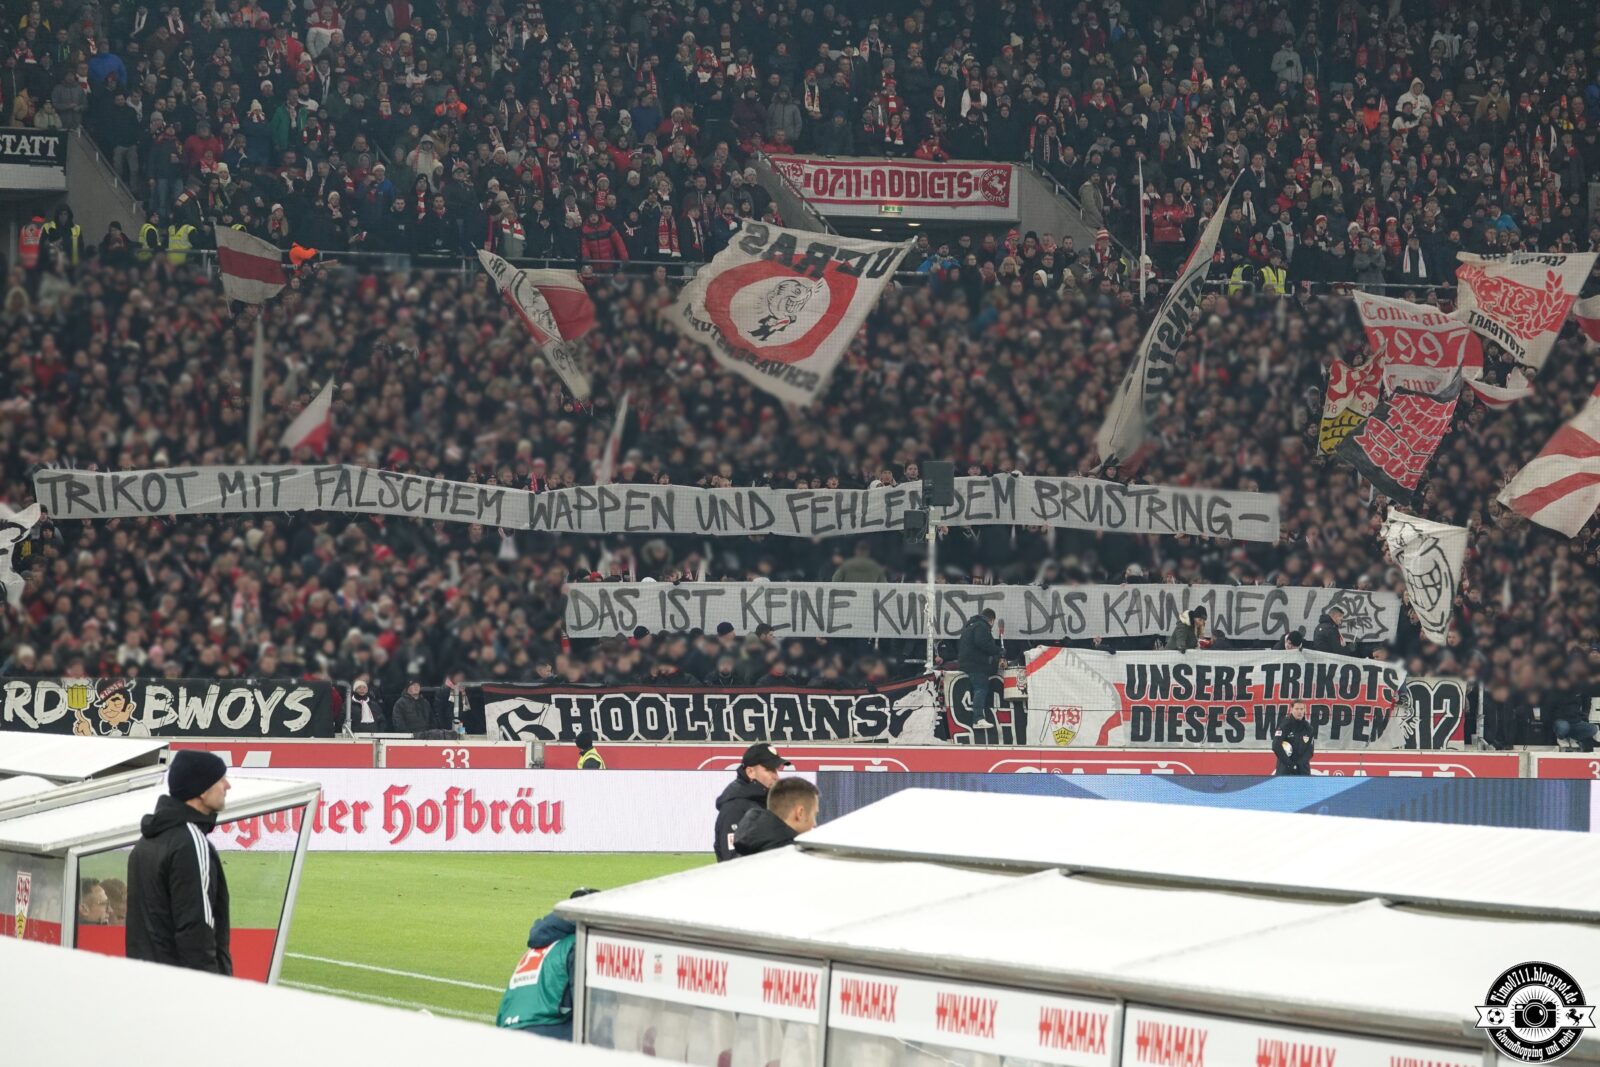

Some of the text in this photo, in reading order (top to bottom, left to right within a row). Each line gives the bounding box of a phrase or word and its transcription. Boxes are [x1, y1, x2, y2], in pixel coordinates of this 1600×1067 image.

[0, 134, 59, 157] TATT
[1372, 328, 1471, 367] 1997
[37, 471, 198, 516] TRIKOT
[217, 468, 298, 508] MIT
[313, 464, 505, 525] FALSCHEM
[528, 486, 675, 532] WAPPEN
[696, 490, 776, 531] UND
[1031, 479, 1233, 539] BRUSTRING
[569, 588, 640, 632] DAS
[659, 588, 726, 630] IST
[741, 586, 857, 633] KEINE
[873, 588, 1006, 637] KUNST
[1019, 590, 1087, 635] DAS
[1103, 588, 1190, 636] KANN
[1125, 662, 1400, 701] UNSERE TRIKOTS
[143, 684, 315, 734] BWOYS
[552, 694, 892, 743] HOOLIGANS
[1131, 705, 1390, 743] DIESES WPPEN
[382, 784, 565, 845] Hofbräu
[595, 942, 645, 983] WINAMAX
[677, 954, 729, 997] WINAMAX
[763, 966, 818, 1010] WINAMAX
[840, 977, 898, 1023] WINAMAX
[936, 991, 998, 1039] WINAMAX
[1039, 1005, 1108, 1055] WINAMAX
[1136, 1020, 1208, 1067] WINAMAX
